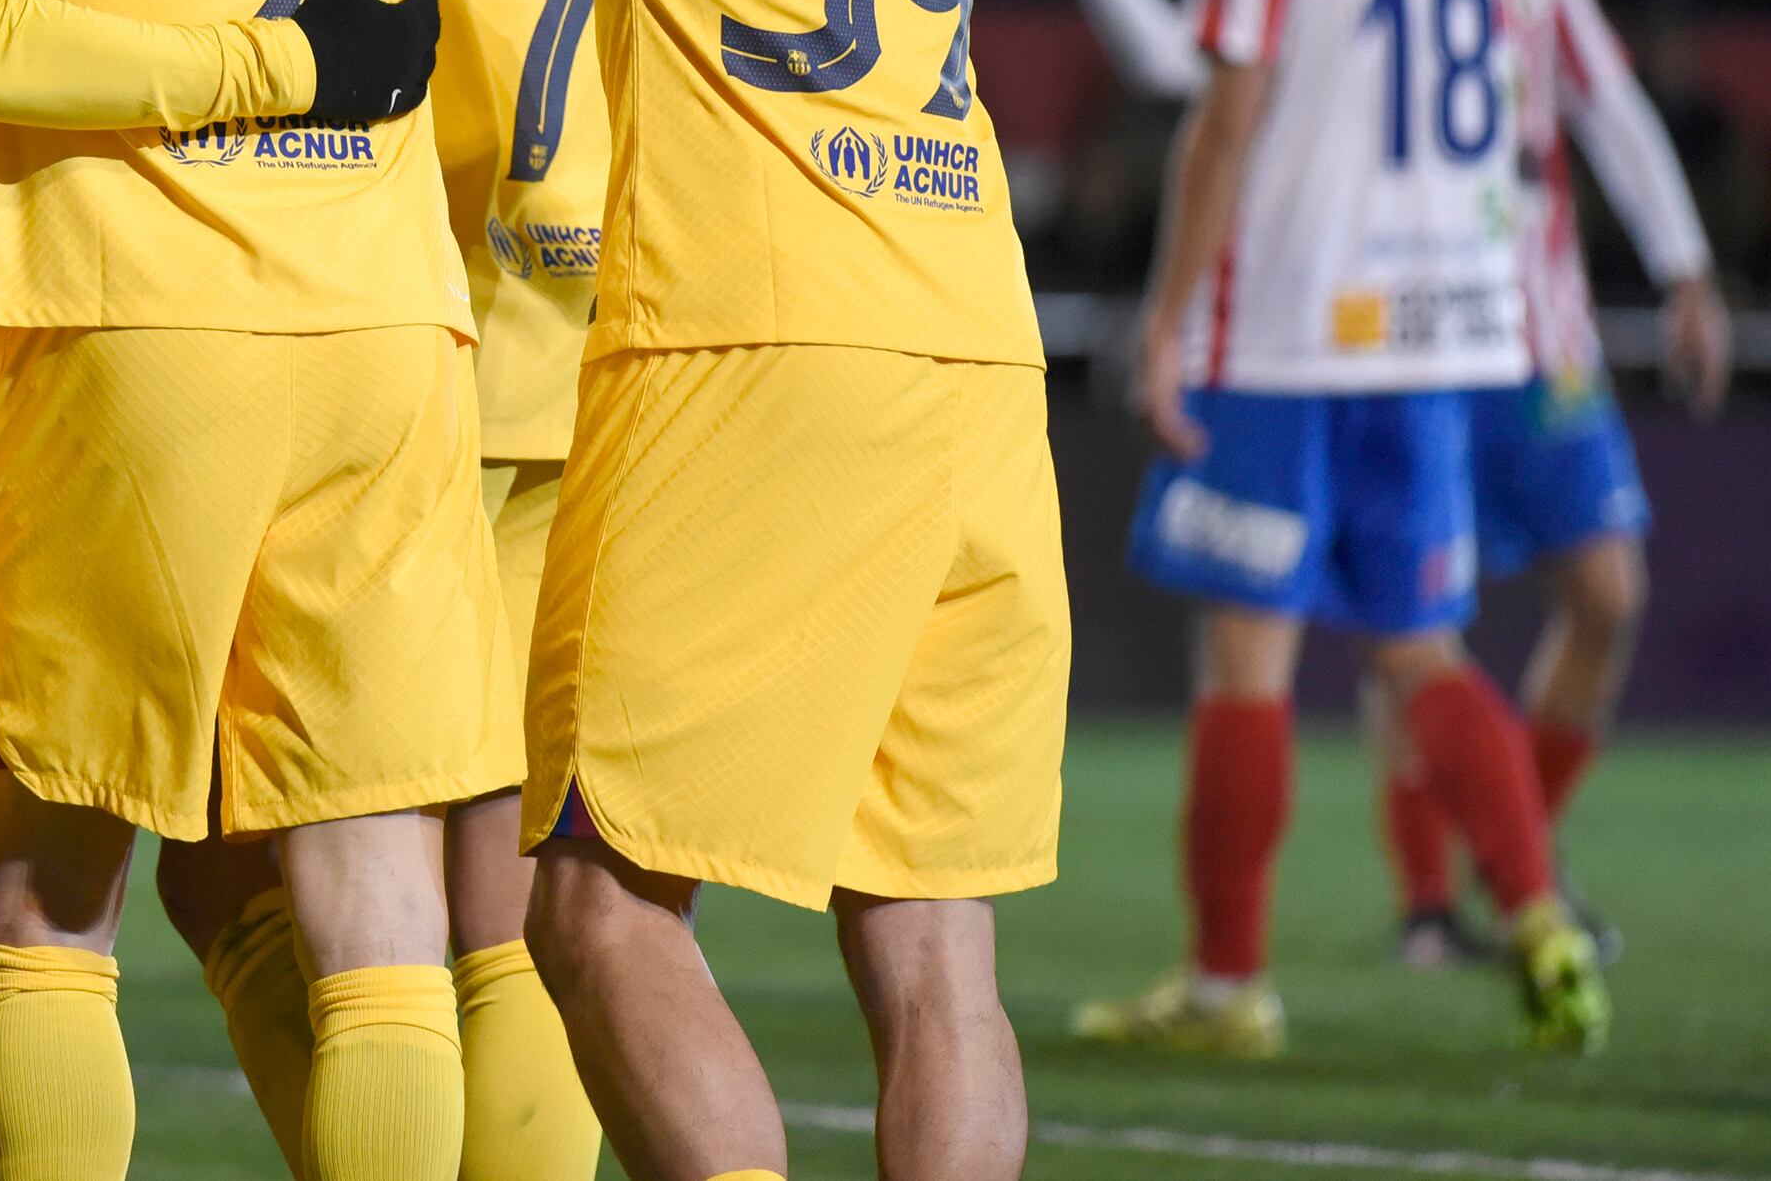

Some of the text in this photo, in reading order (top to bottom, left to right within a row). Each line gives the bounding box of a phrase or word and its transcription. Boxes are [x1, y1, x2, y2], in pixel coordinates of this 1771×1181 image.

[254, 131, 374, 160] ACNUR
[894, 135, 979, 174] UNHCR
[256, 160, 276, 169] The
[278, 161, 294, 169] UN
[894, 164, 980, 202] ACNUR
[895, 193, 910, 204] The
[911, 196, 923, 206] UN
